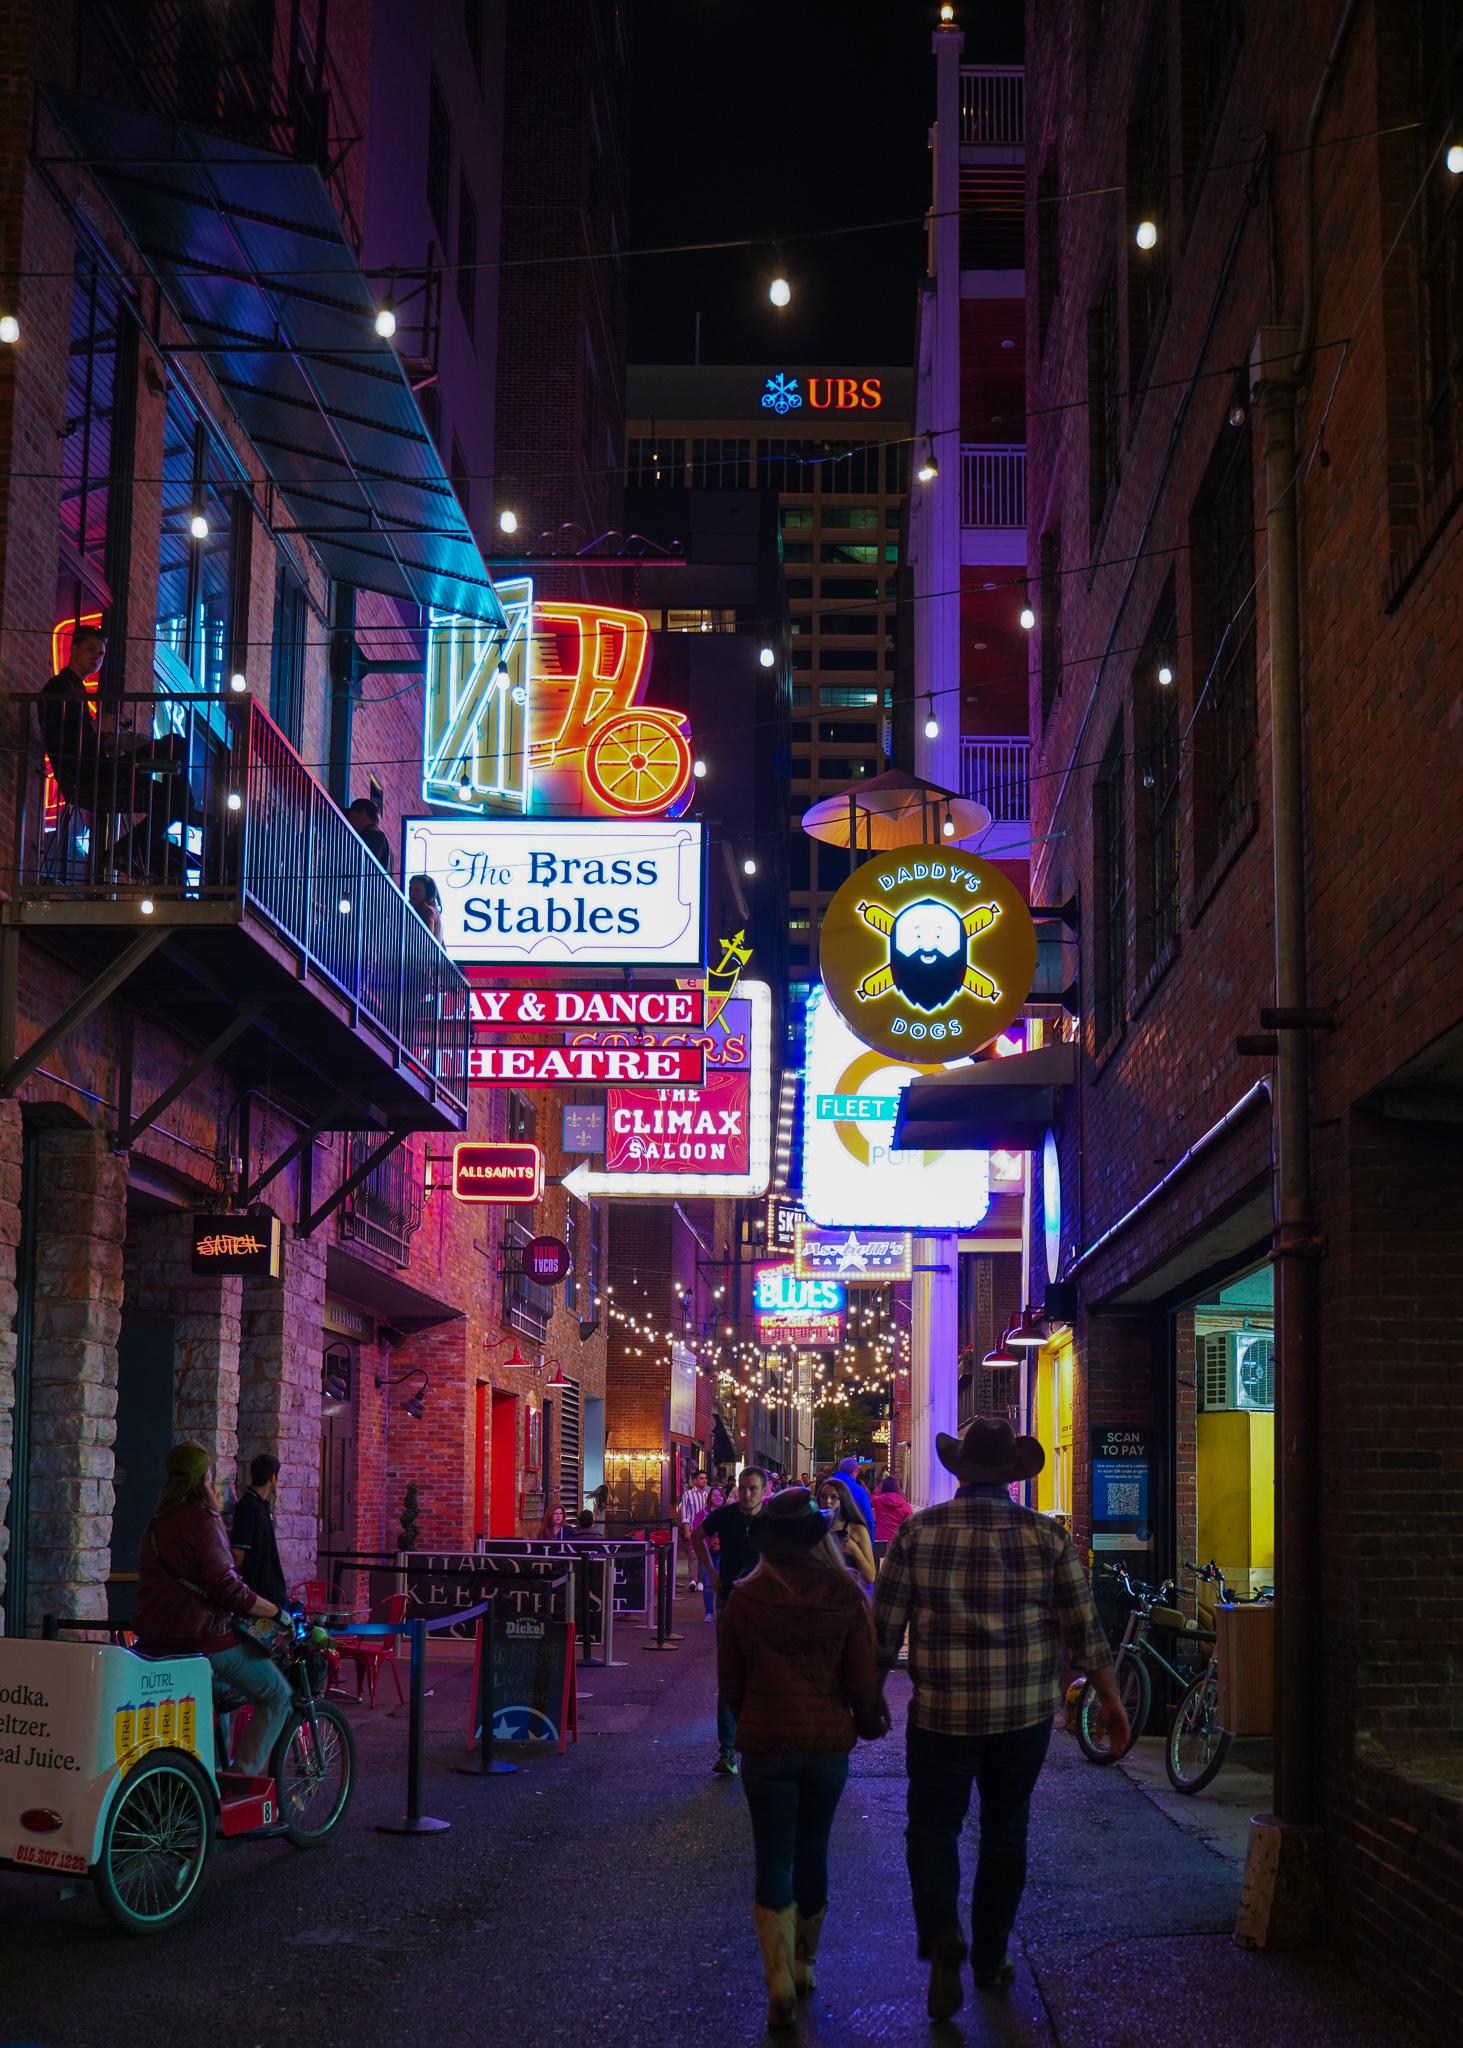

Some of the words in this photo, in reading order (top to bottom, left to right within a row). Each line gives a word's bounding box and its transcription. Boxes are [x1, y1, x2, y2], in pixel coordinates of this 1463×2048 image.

[806, 378, 883, 409] UBS
[446, 849, 512, 889] The
[527, 851, 658, 886] Brass
[878, 861, 982, 893] DADDY'S
[463, 897, 641, 935] Stables
[517, 992, 546, 1021] &
[555, 993, 693, 1023] DANCE
[892, 1017, 963, 1040] DOGS
[657, 1088, 701, 1103] THE
[820, 1098, 884, 1118] FLEET
[614, 1109, 742, 1135] CLIMAX
[629, 1142, 726, 1161] SALOON
[458, 1165, 535, 1179] ALLSAINTS
[760, 1276, 838, 1308] BLUES
[1107, 1432, 1140, 1443] SCAN
[1102, 1445, 1118, 1455] TO
[1121, 1445, 1144, 1455] PAY
[0, 1685, 49, 1707] odka.
[0, 1714, 50, 1738] eltzer.
[0, 1745, 20, 1765] eal
[25, 1747, 81, 1772] Juice.
[264, 1801, 270, 1820] 8
